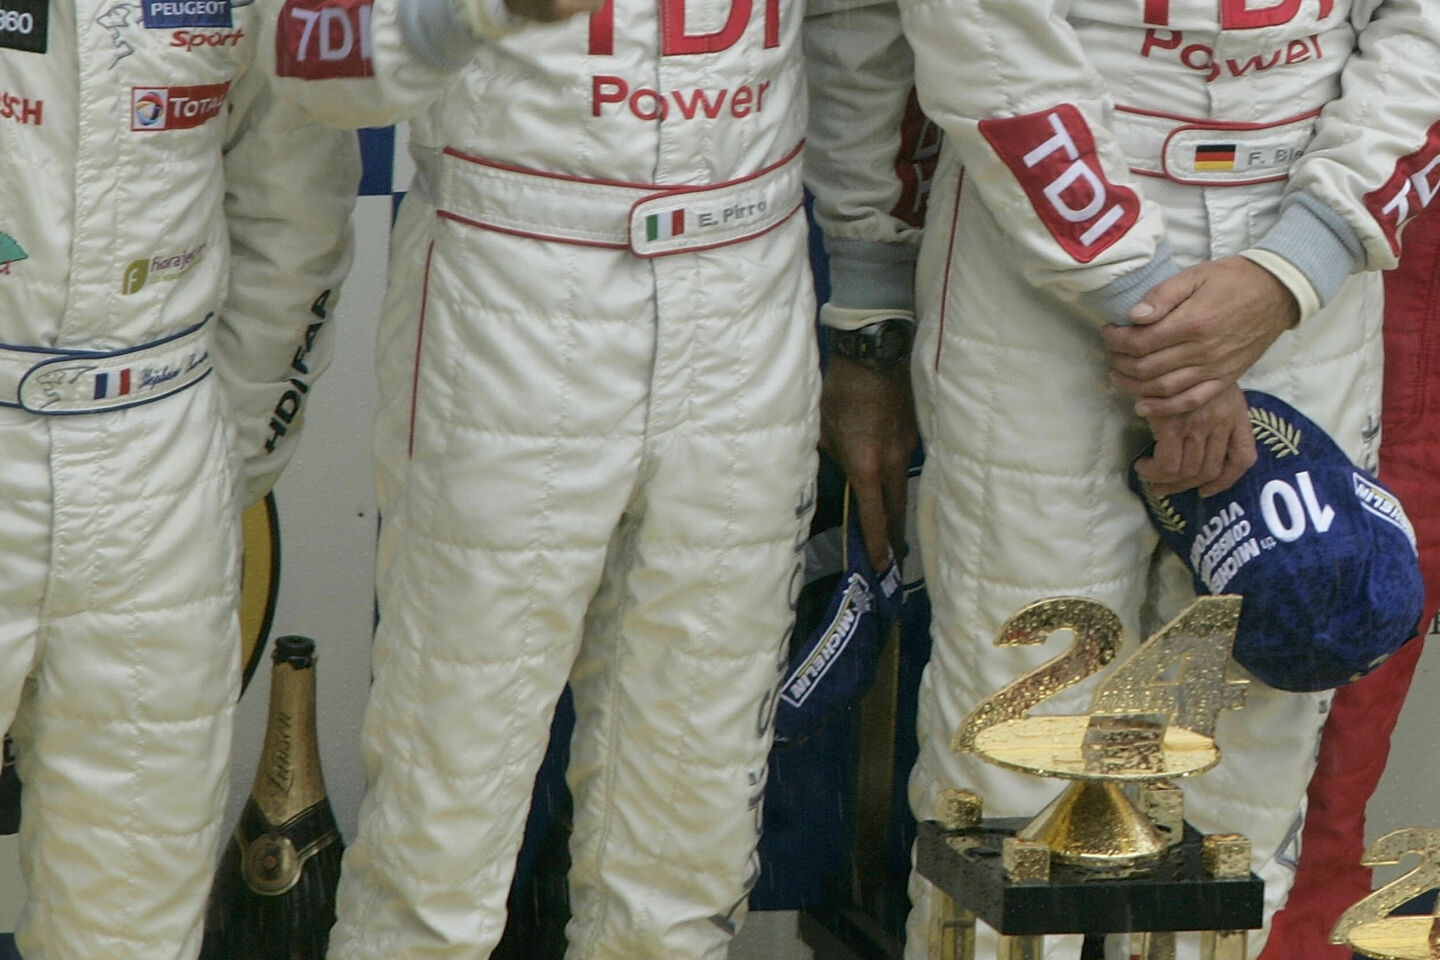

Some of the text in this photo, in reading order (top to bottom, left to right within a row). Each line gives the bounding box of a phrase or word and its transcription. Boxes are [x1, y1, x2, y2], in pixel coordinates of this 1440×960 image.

[150, 0, 226, 17] PEUGEOT
[169, 29, 245, 52] Sport
[1141, 28, 1323, 83] Power
[593, 75, 771, 123] Power
[1022, 113, 1125, 247] TDI
[698, 199, 767, 227] E. Pirro
[789, 608, 856, 700] MICHELIN
[953, 594, 1250, 754] 24
